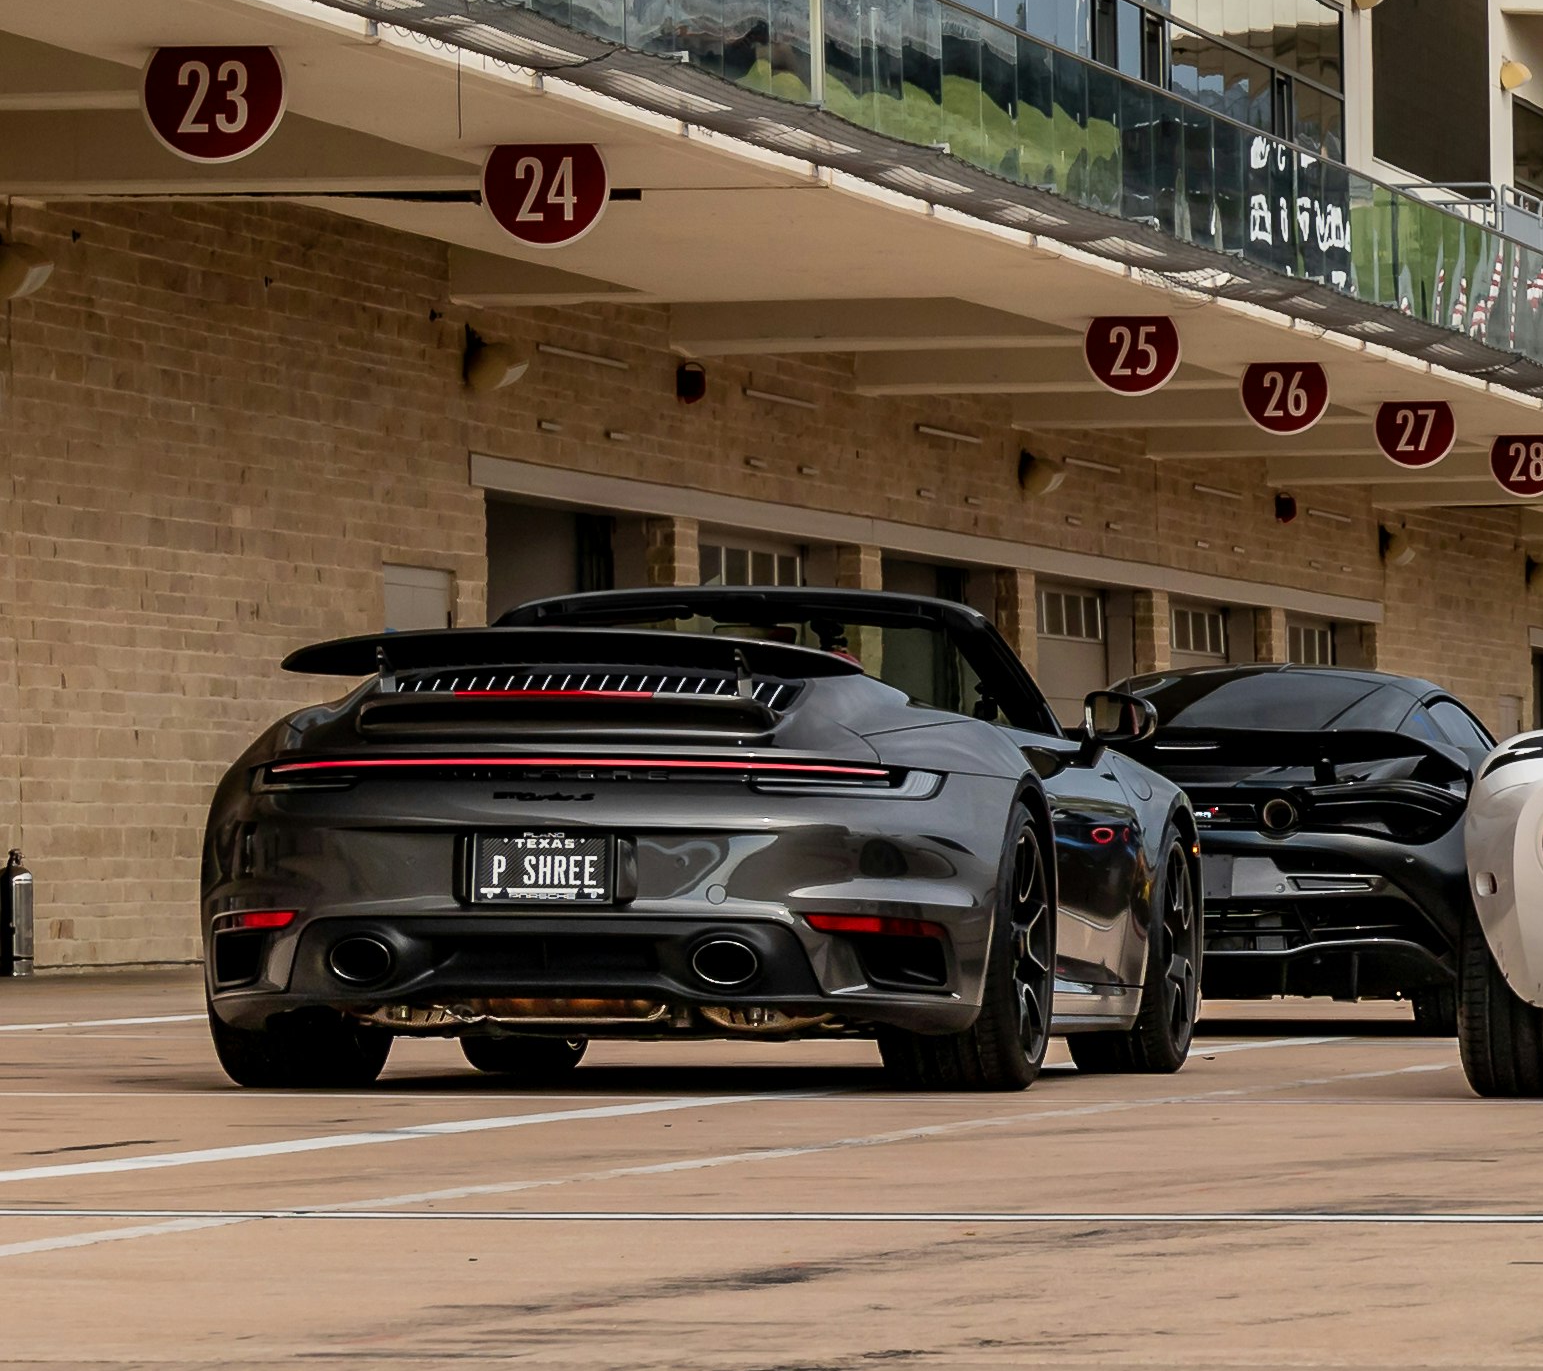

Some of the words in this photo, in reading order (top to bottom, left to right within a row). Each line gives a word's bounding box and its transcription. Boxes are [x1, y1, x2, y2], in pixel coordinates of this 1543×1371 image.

[177, 59, 249, 134] 23
[514, 156, 578, 223] 24
[1109, 325, 1158, 377] 25
[1262, 371, 1308, 418] 26
[1395, 408, 1437, 452] 27
[514, 838, 576, 849] TEXAS
[492, 855, 507, 886] P
[522, 855, 598, 886] SHREE
